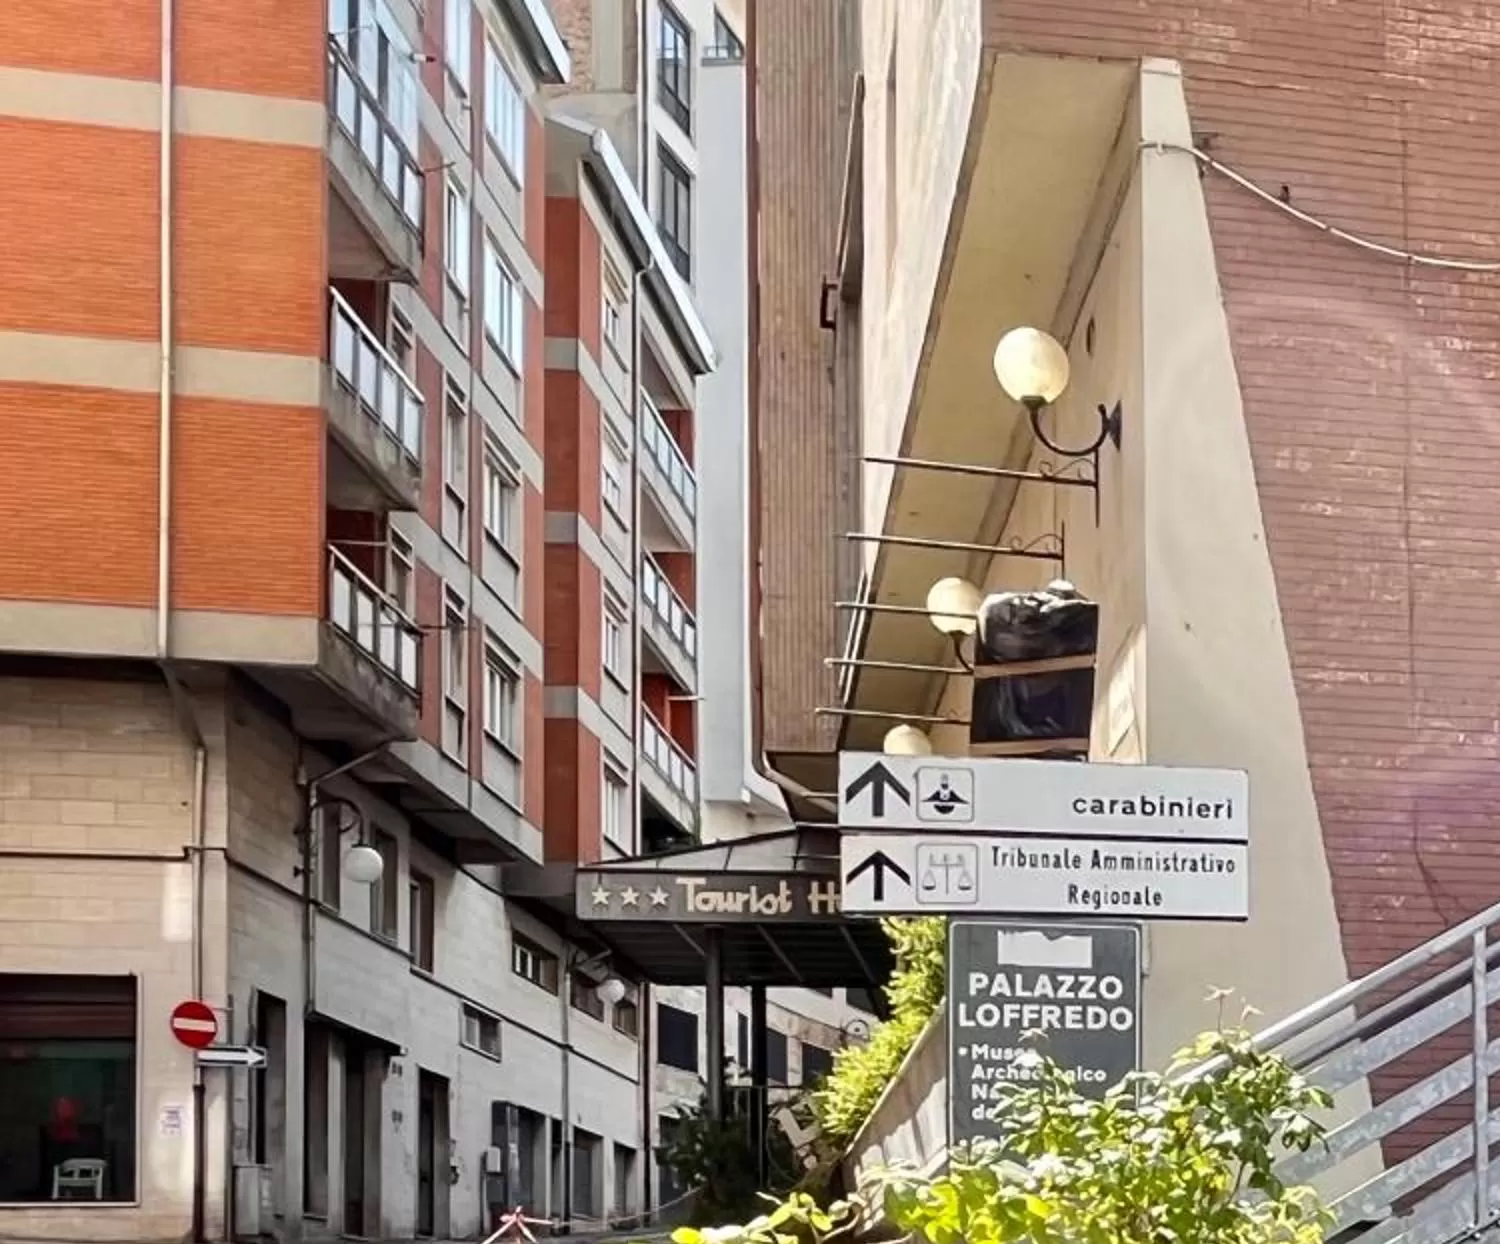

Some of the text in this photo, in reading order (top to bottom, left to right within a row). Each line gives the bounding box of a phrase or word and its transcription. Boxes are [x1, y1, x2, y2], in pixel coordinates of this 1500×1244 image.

[1072, 796, 1233, 820] carabinieri
[992, 845, 1236, 875] Tribunale Amministrativo
[1067, 883, 1163, 909] Regionale
[968, 972, 1123, 999] PALAZZO
[959, 1003, 1134, 1031] LOFFREDO
